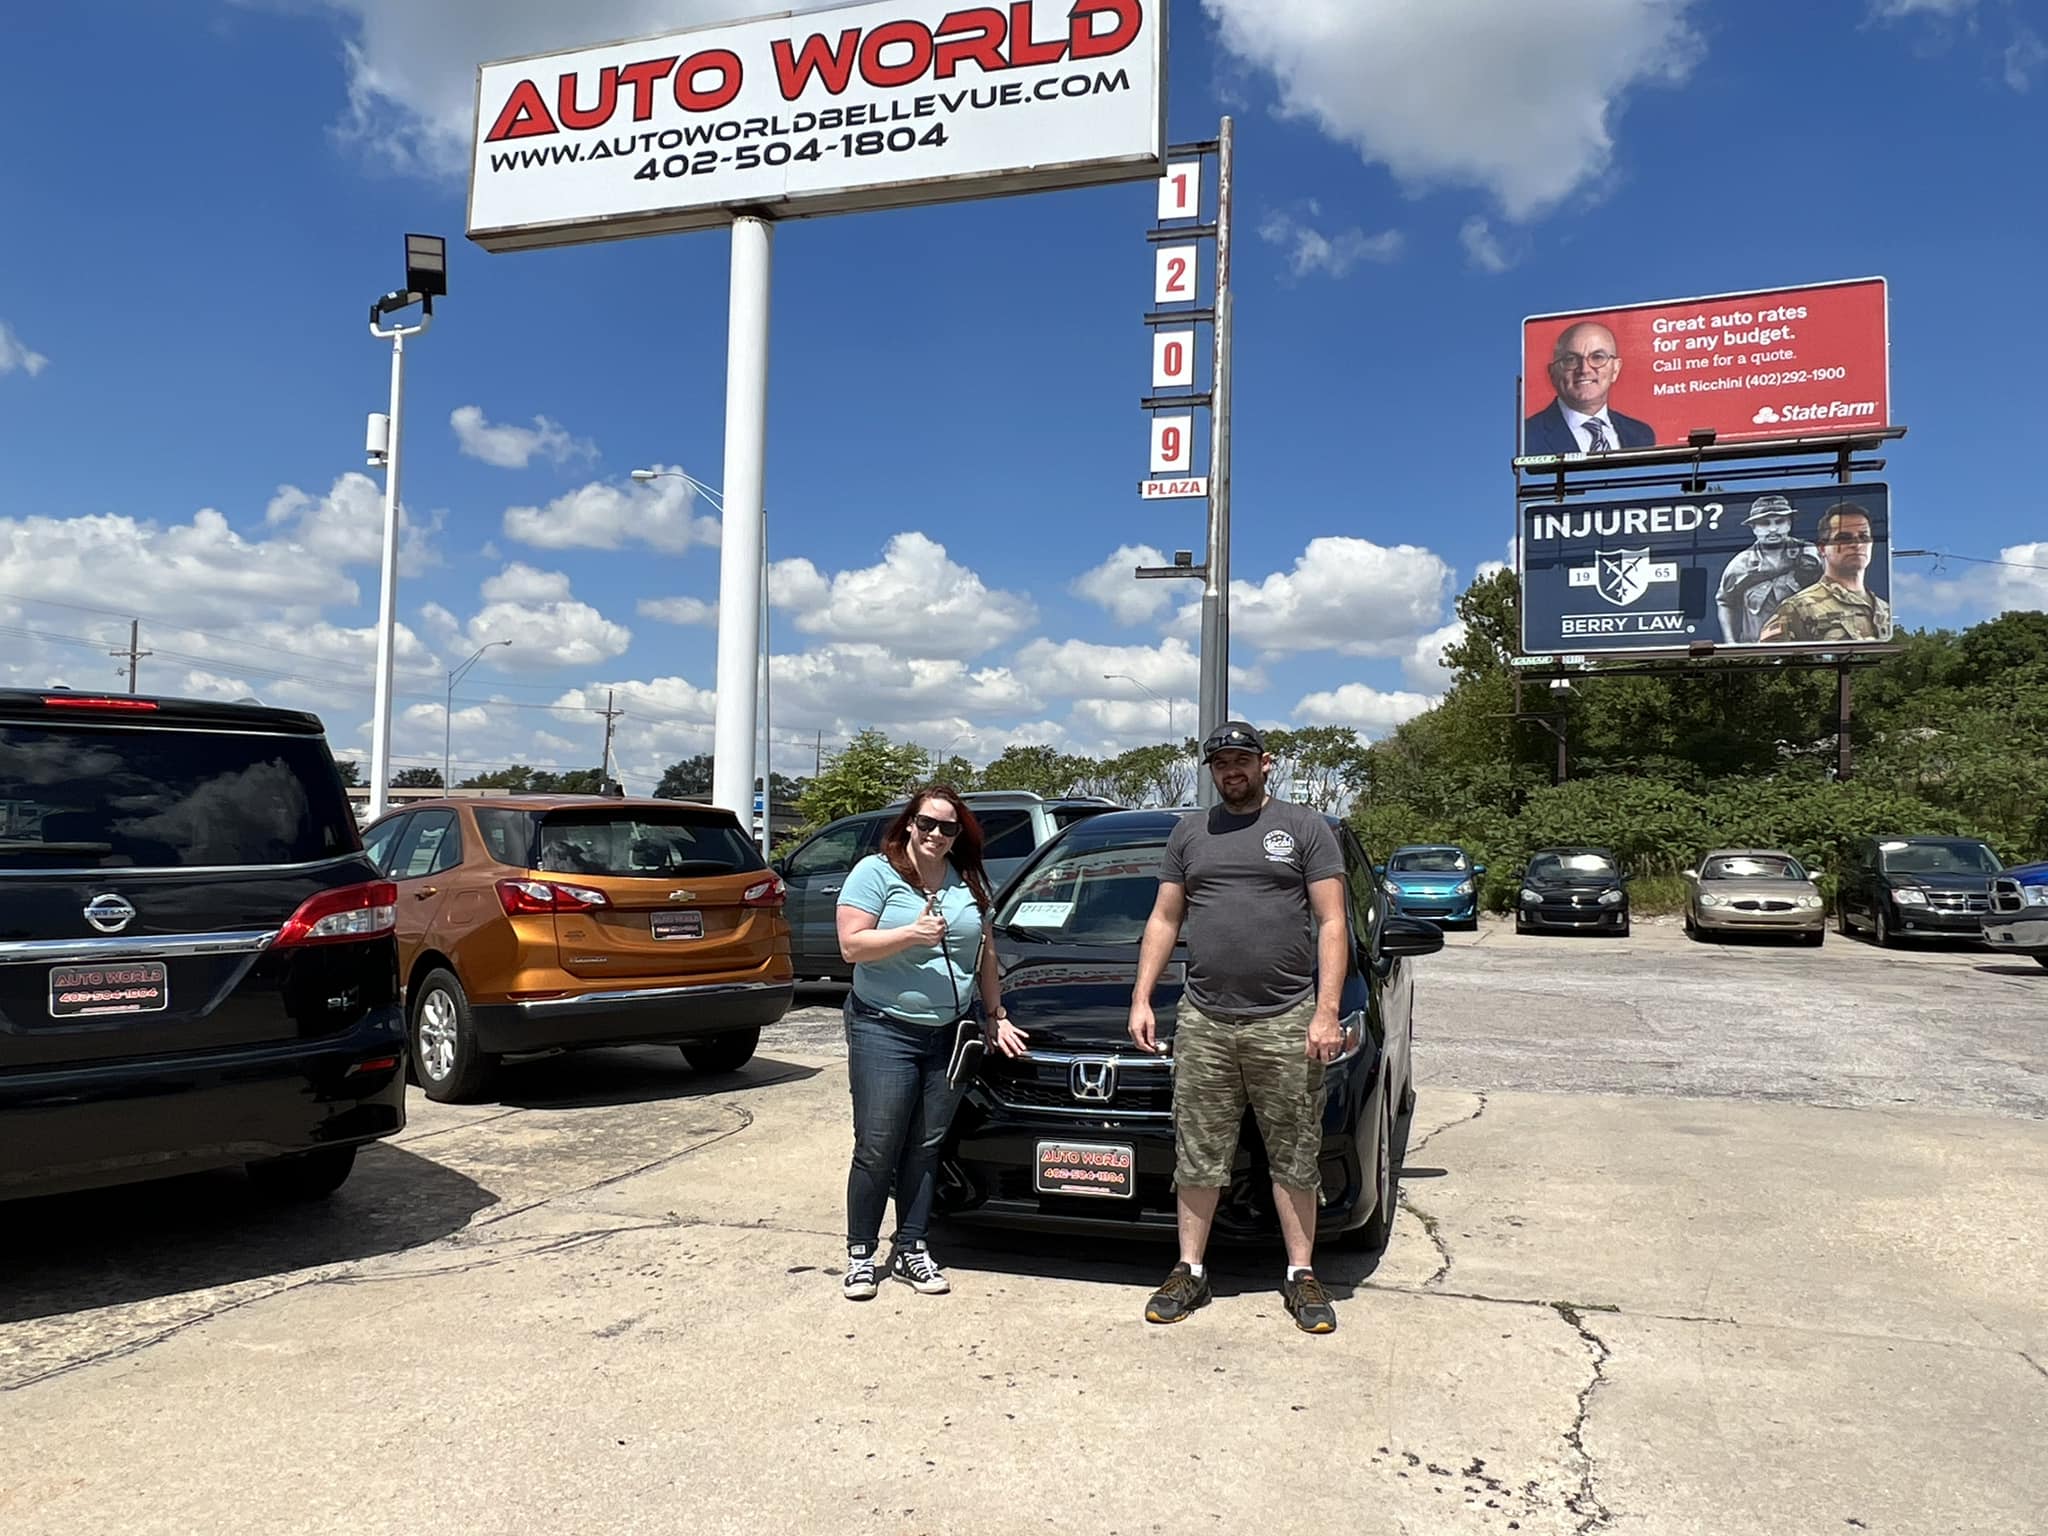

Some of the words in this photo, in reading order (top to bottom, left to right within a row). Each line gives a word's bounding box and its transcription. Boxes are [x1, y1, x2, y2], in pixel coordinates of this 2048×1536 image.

[484, 48, 743, 143] AUTO
[771, 0, 1143, 101] WORLD
[490, 69, 1130, 172] WWW.AUTOWORLDBELLEVUE.COM
[634, 122, 948, 182] 402-504-1804
[1171, 174, 1187, 208] 1
[1166, 257, 1186, 292] 2
[1652, 315, 1706, 333] Great
[1711, 312, 1753, 328] auto
[1758, 306, 1808, 323] rates
[1652, 337, 1680, 353] for
[1685, 334, 1719, 351] any
[1723, 325, 1796, 346] budget.
[1164, 341, 1182, 376] 0
[1653, 358, 1682, 373] Call
[1686, 356, 1709, 369] me
[1713, 354, 1734, 368] for
[1737, 354, 1747, 365] a
[1751, 349, 1797, 366] quote.
[1653, 383, 1686, 396] Matt
[1689, 376, 1742, 393] Ricchini
[1745, 366, 1846, 389] (402)292-1900
[1161, 426, 1180, 462] 9
[1147, 481, 1201, 496] PLAZA
[1533, 503, 1724, 541] INJURED?
[1575, 571, 1590, 582] 19
[1655, 568, 1670, 578] 65
[1561, 617, 1629, 634] BERRY
[54, 972, 103, 987] AUTO
[106, 969, 163, 984] WORLD
[1040, 1150, 1080, 1164] AUTO
[1081, 1152, 1130, 1168] WORLD
